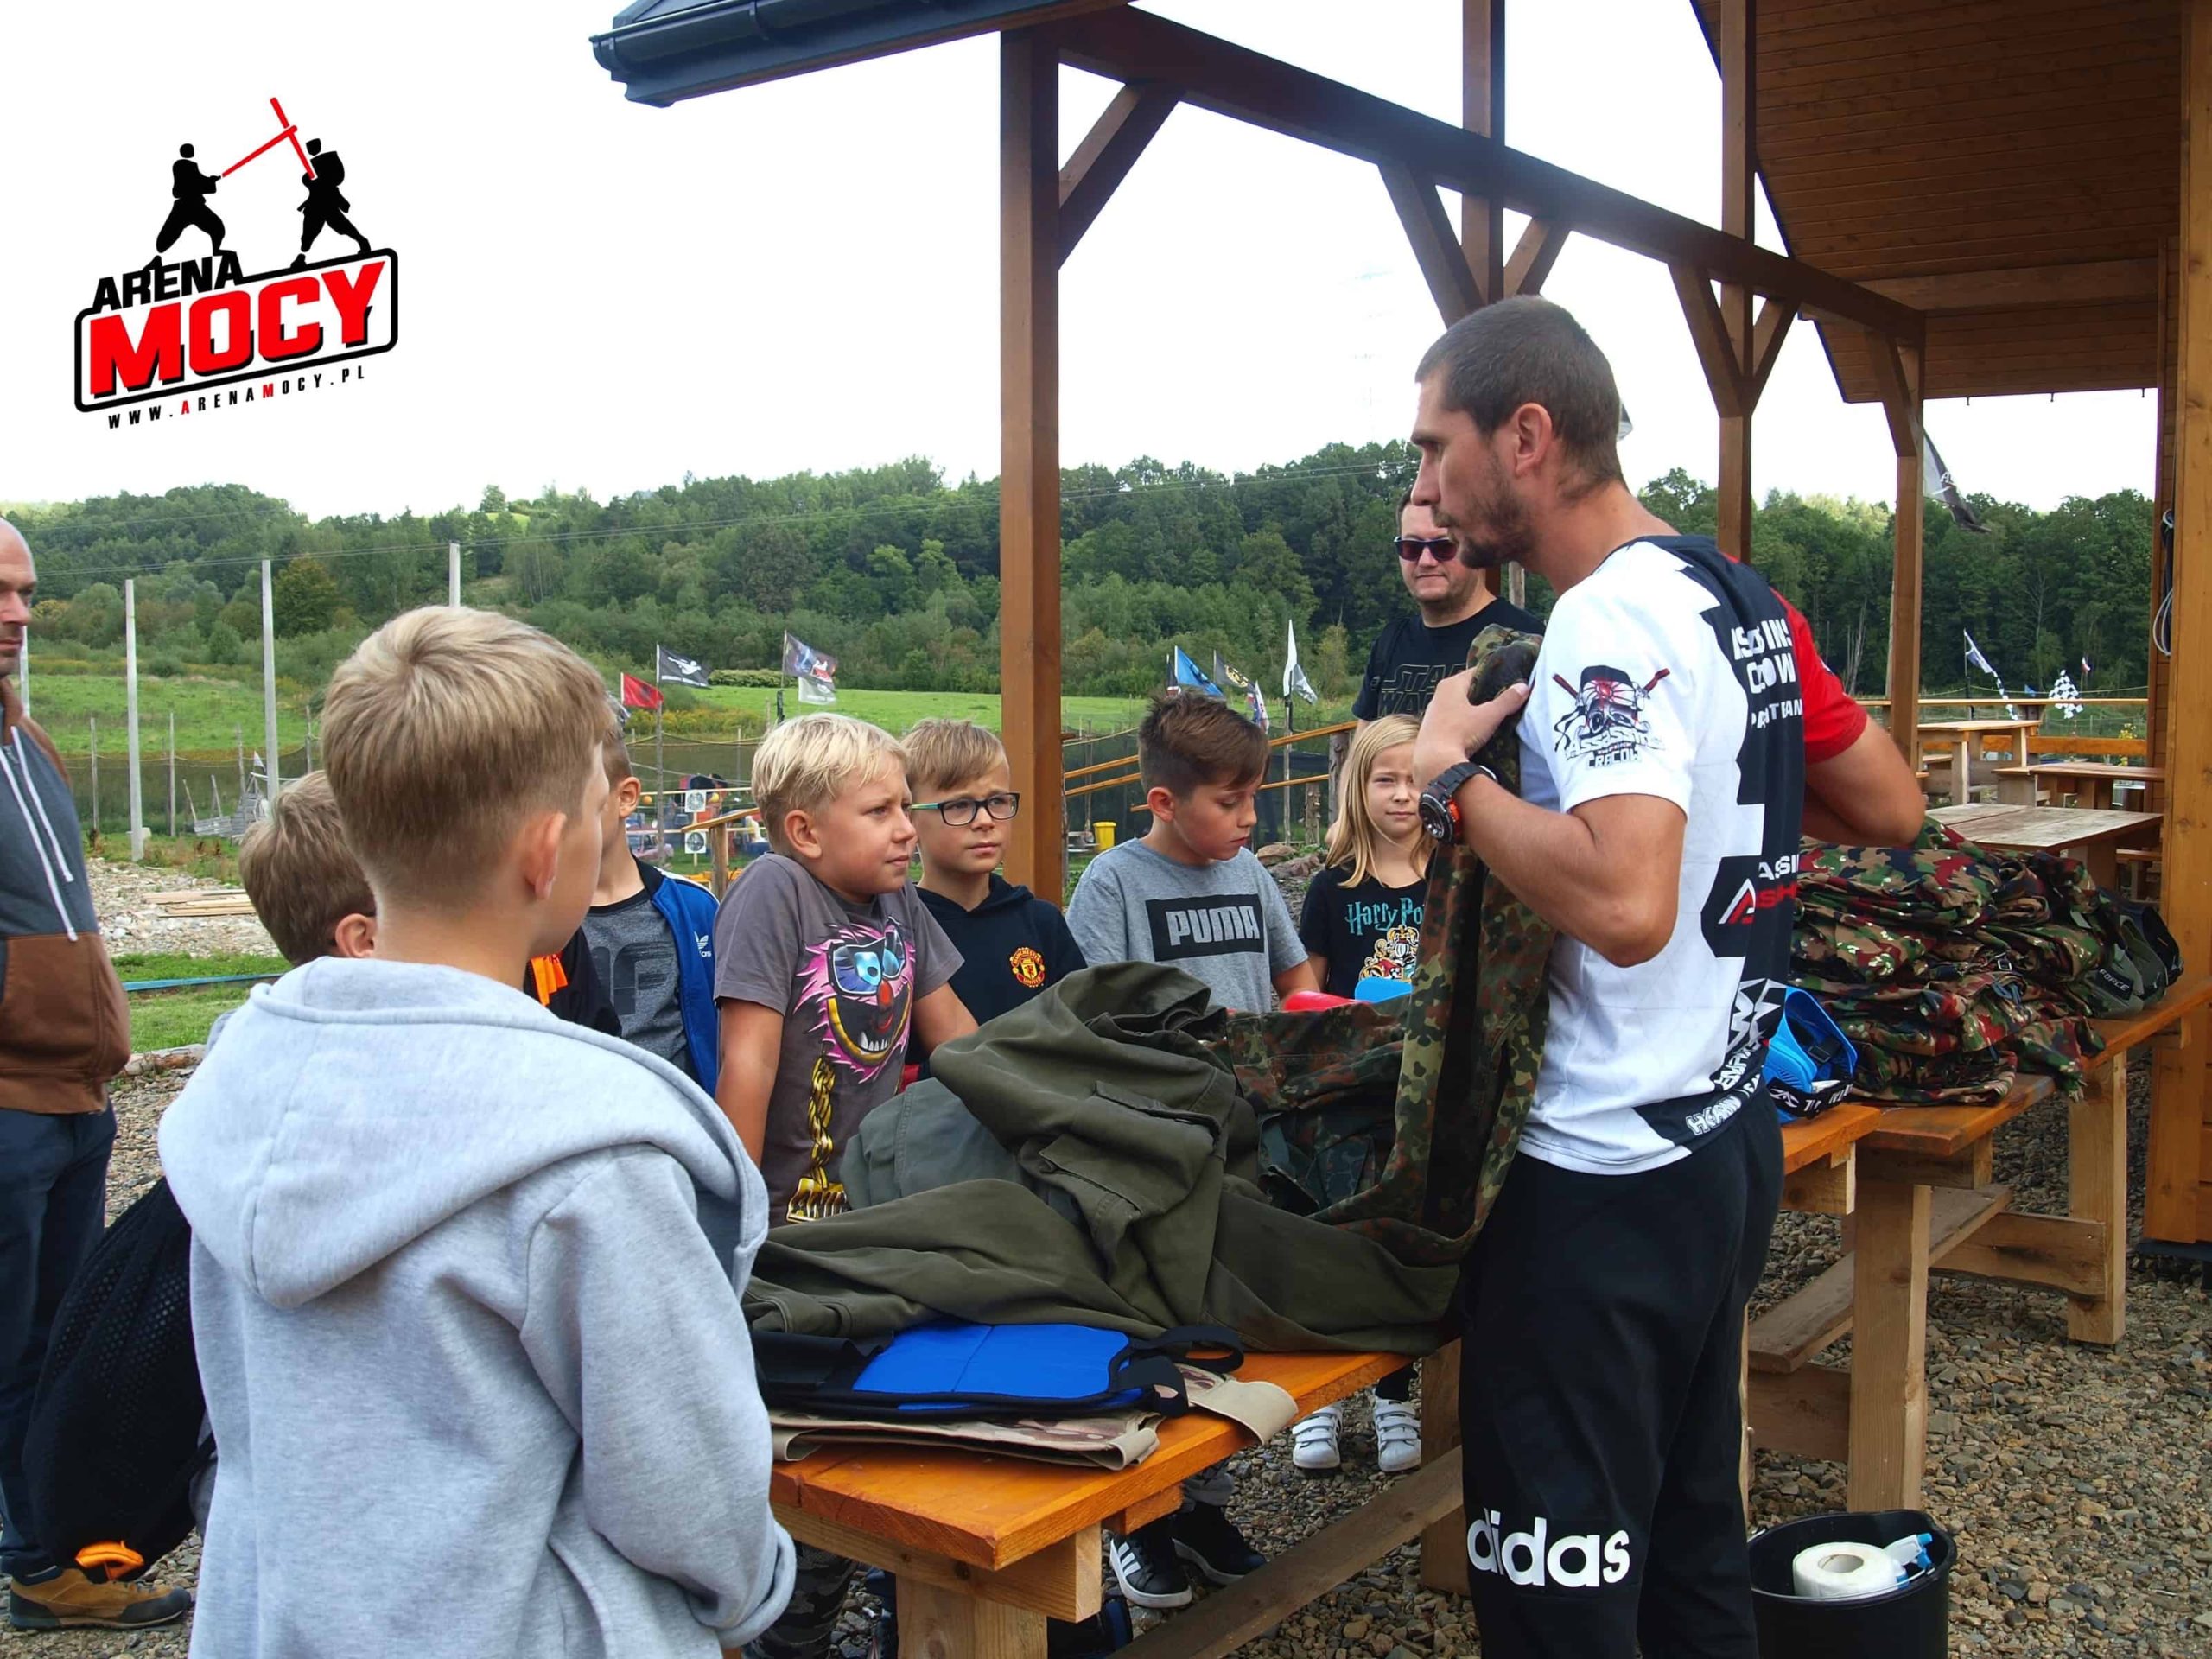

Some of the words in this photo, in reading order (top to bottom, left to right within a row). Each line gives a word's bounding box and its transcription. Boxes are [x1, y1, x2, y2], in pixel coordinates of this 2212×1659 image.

[1165, 906, 1261, 946] PUMA
[1344, 901, 1399, 936] Harry
[2099, 969, 2130, 991] FORCE
[1467, 1507, 1630, 1588] adidas
